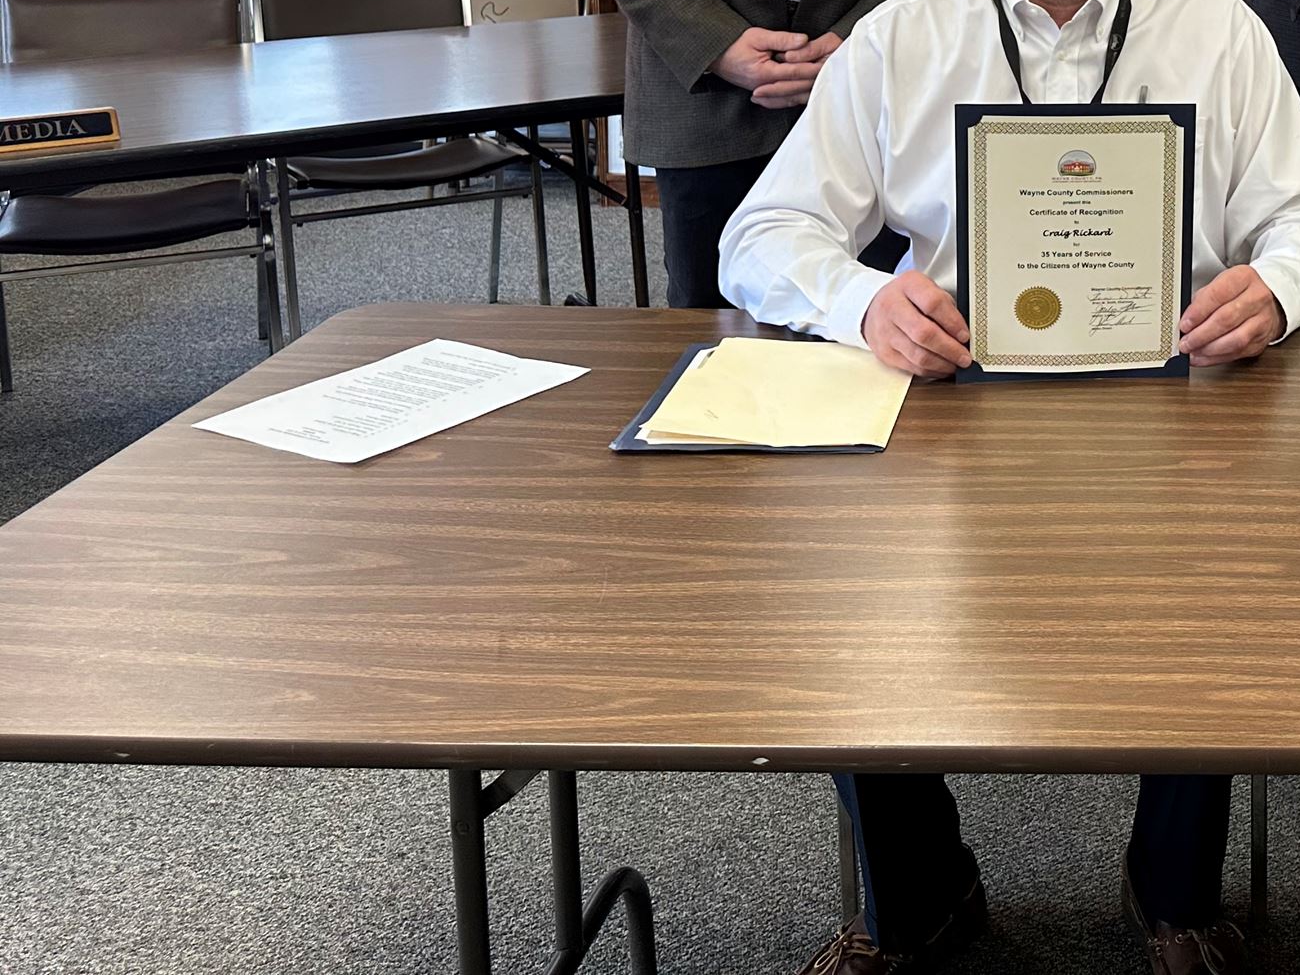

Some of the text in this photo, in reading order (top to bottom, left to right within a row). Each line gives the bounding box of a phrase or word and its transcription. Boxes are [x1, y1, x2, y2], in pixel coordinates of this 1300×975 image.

[1020, 189, 1045, 197] Wayne
[1047, 189, 1074, 197] County
[1043, 228, 1113, 239] Craig Rickard
